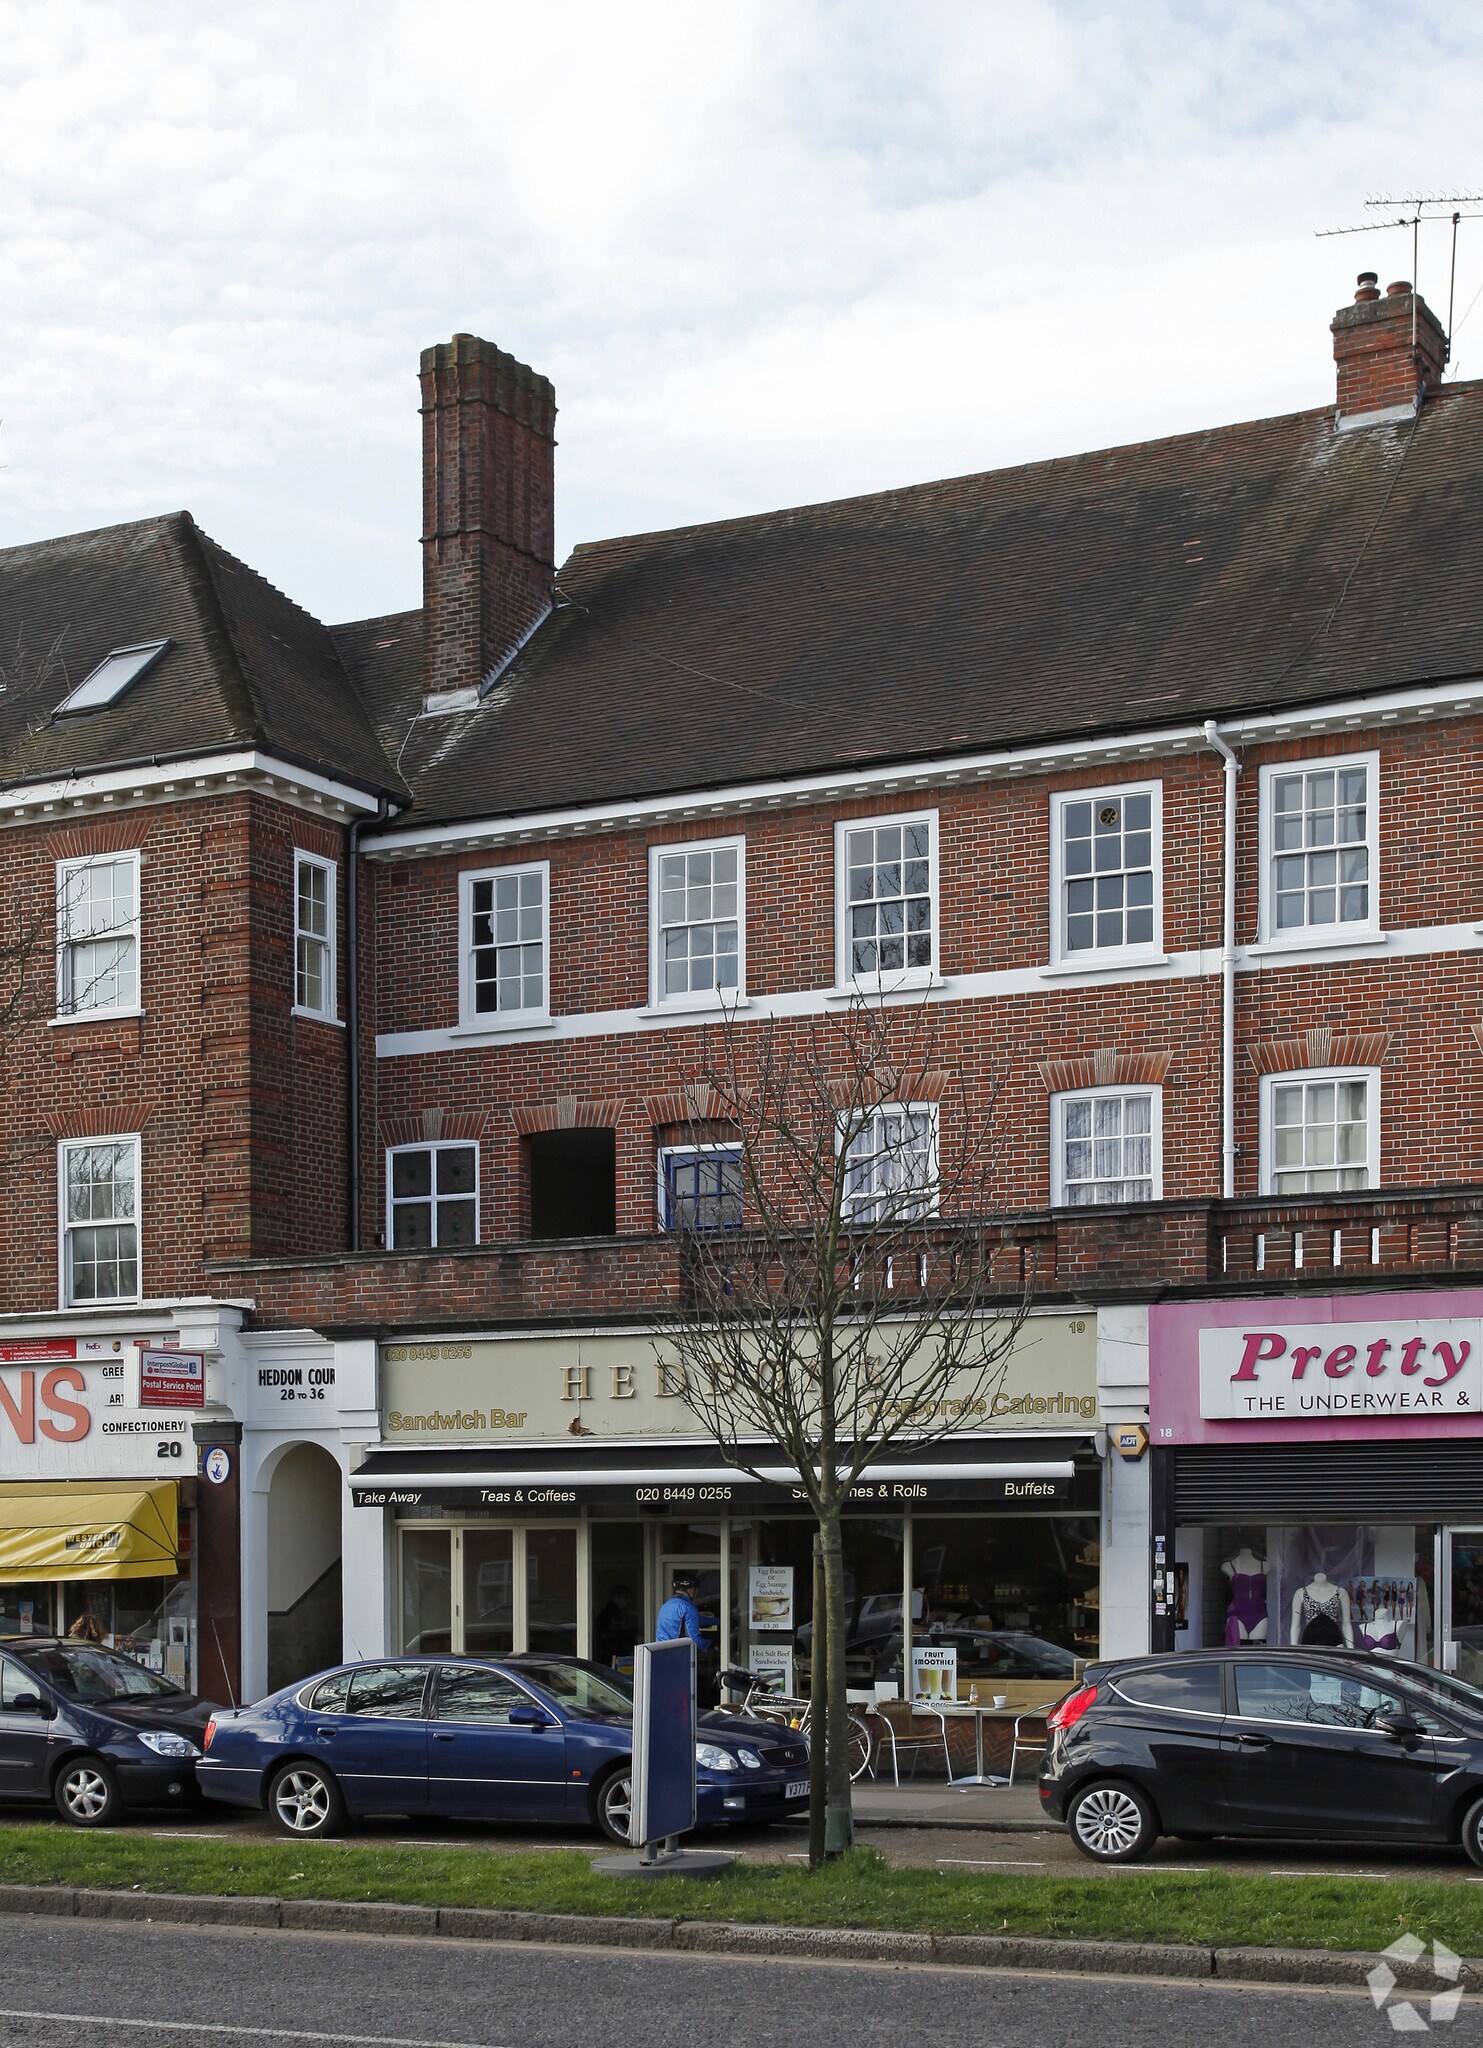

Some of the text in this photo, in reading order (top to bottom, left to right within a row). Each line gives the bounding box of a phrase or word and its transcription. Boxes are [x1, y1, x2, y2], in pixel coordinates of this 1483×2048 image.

[1069, 1321, 1085, 1334] 19
[85, 1342, 101, 1350] FedEx
[385, 1346, 473, 1361] 020 8449 0255
[1231, 1333, 1471, 1387] Pretty
[147, 1360, 189, 1370] InterpostGlobal
[258, 1368, 302, 1386] HEDDON
[142, 1380, 203, 1391] Postal Service Point
[280, 1389, 295, 1400] 28
[309, 1388, 325, 1400] 36
[991, 1392, 1096, 1418] Catering
[1244, 1391, 1470, 1412] THE UNDERWEAR &
[102, 1421, 184, 1432] CONFECTIONERY
[388, 1409, 528, 1431] Sandwich Bar
[1159, 1428, 1173, 1438] 18
[1120, 1437, 1137, 1445] ADT
[157, 1441, 182, 1458] 20
[636, 1487, 732, 1500] 020 8449 0255
[878, 1484, 888, 1497] &
[893, 1484, 927, 1497] Rolls
[1004, 1482, 1055, 1495] Buffets
[357, 1491, 422, 1505] Take Away
[480, 1489, 576, 1502] Teas & Coffees
